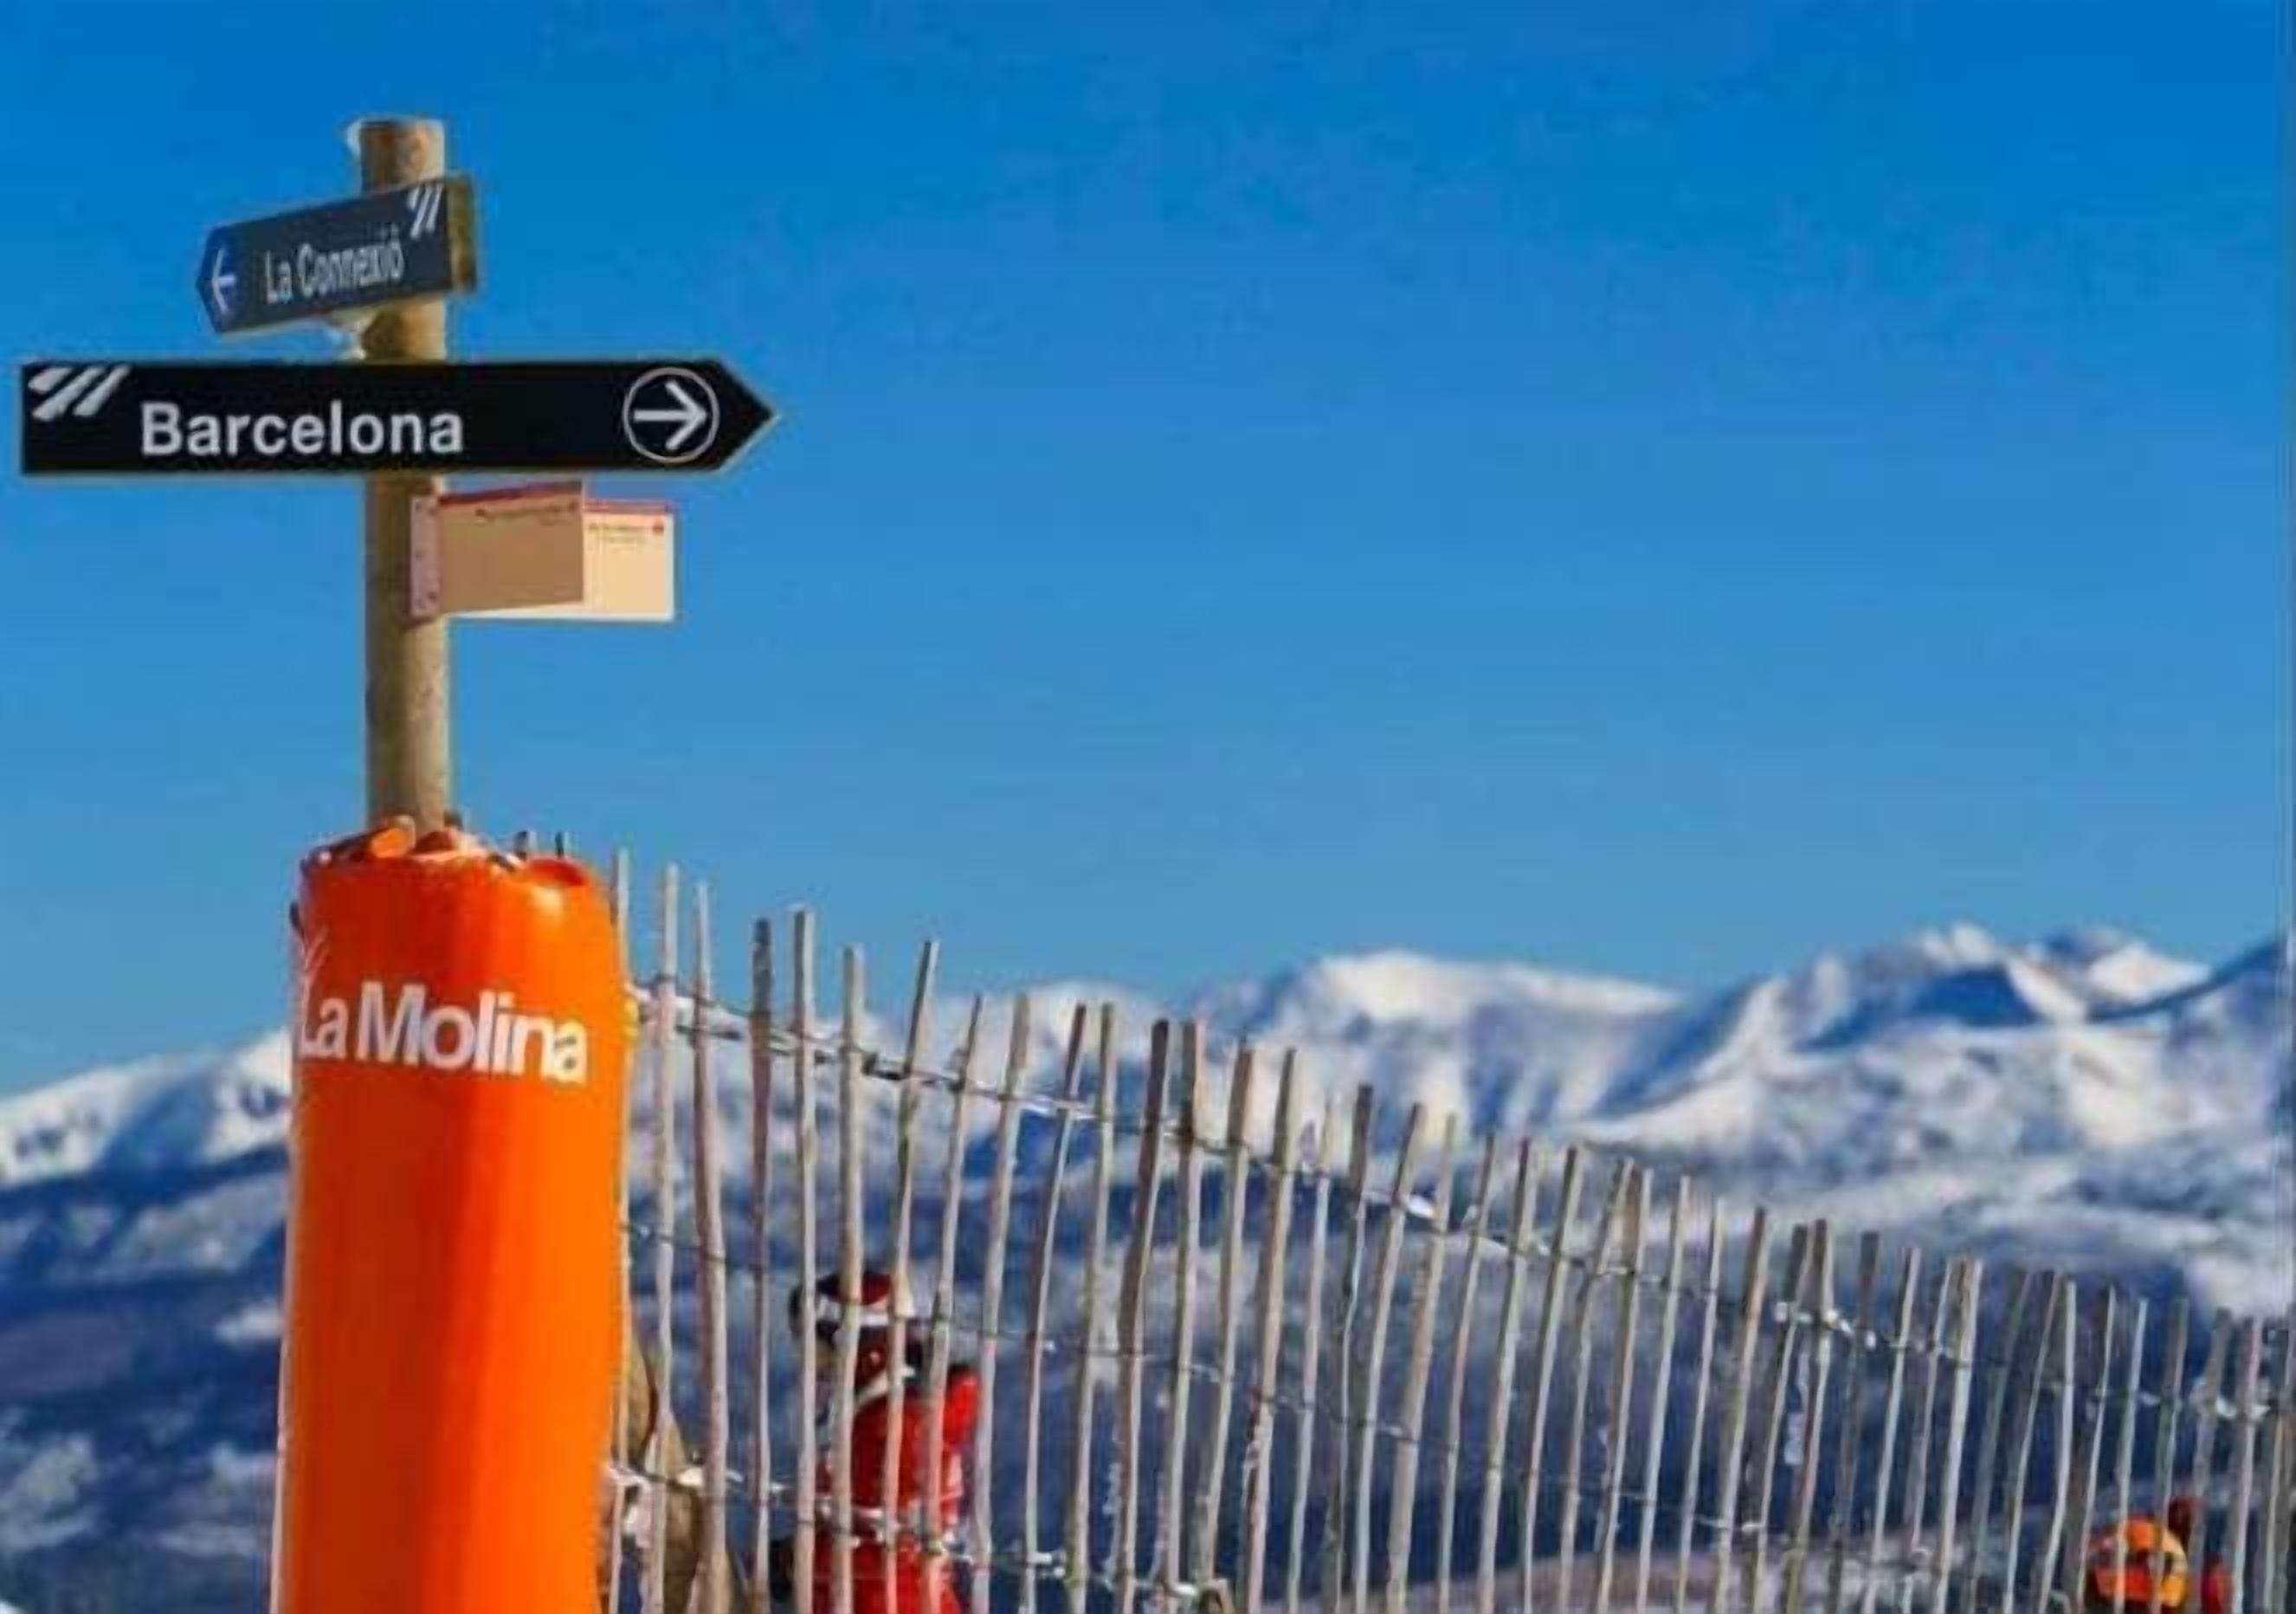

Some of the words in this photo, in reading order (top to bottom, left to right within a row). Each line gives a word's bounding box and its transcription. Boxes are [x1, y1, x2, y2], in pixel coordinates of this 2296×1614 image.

[264, 250, 293, 303] La
[140, 399, 465, 456] Barcelona
[299, 975, 347, 1060] La
[354, 979, 588, 1086] Molina
